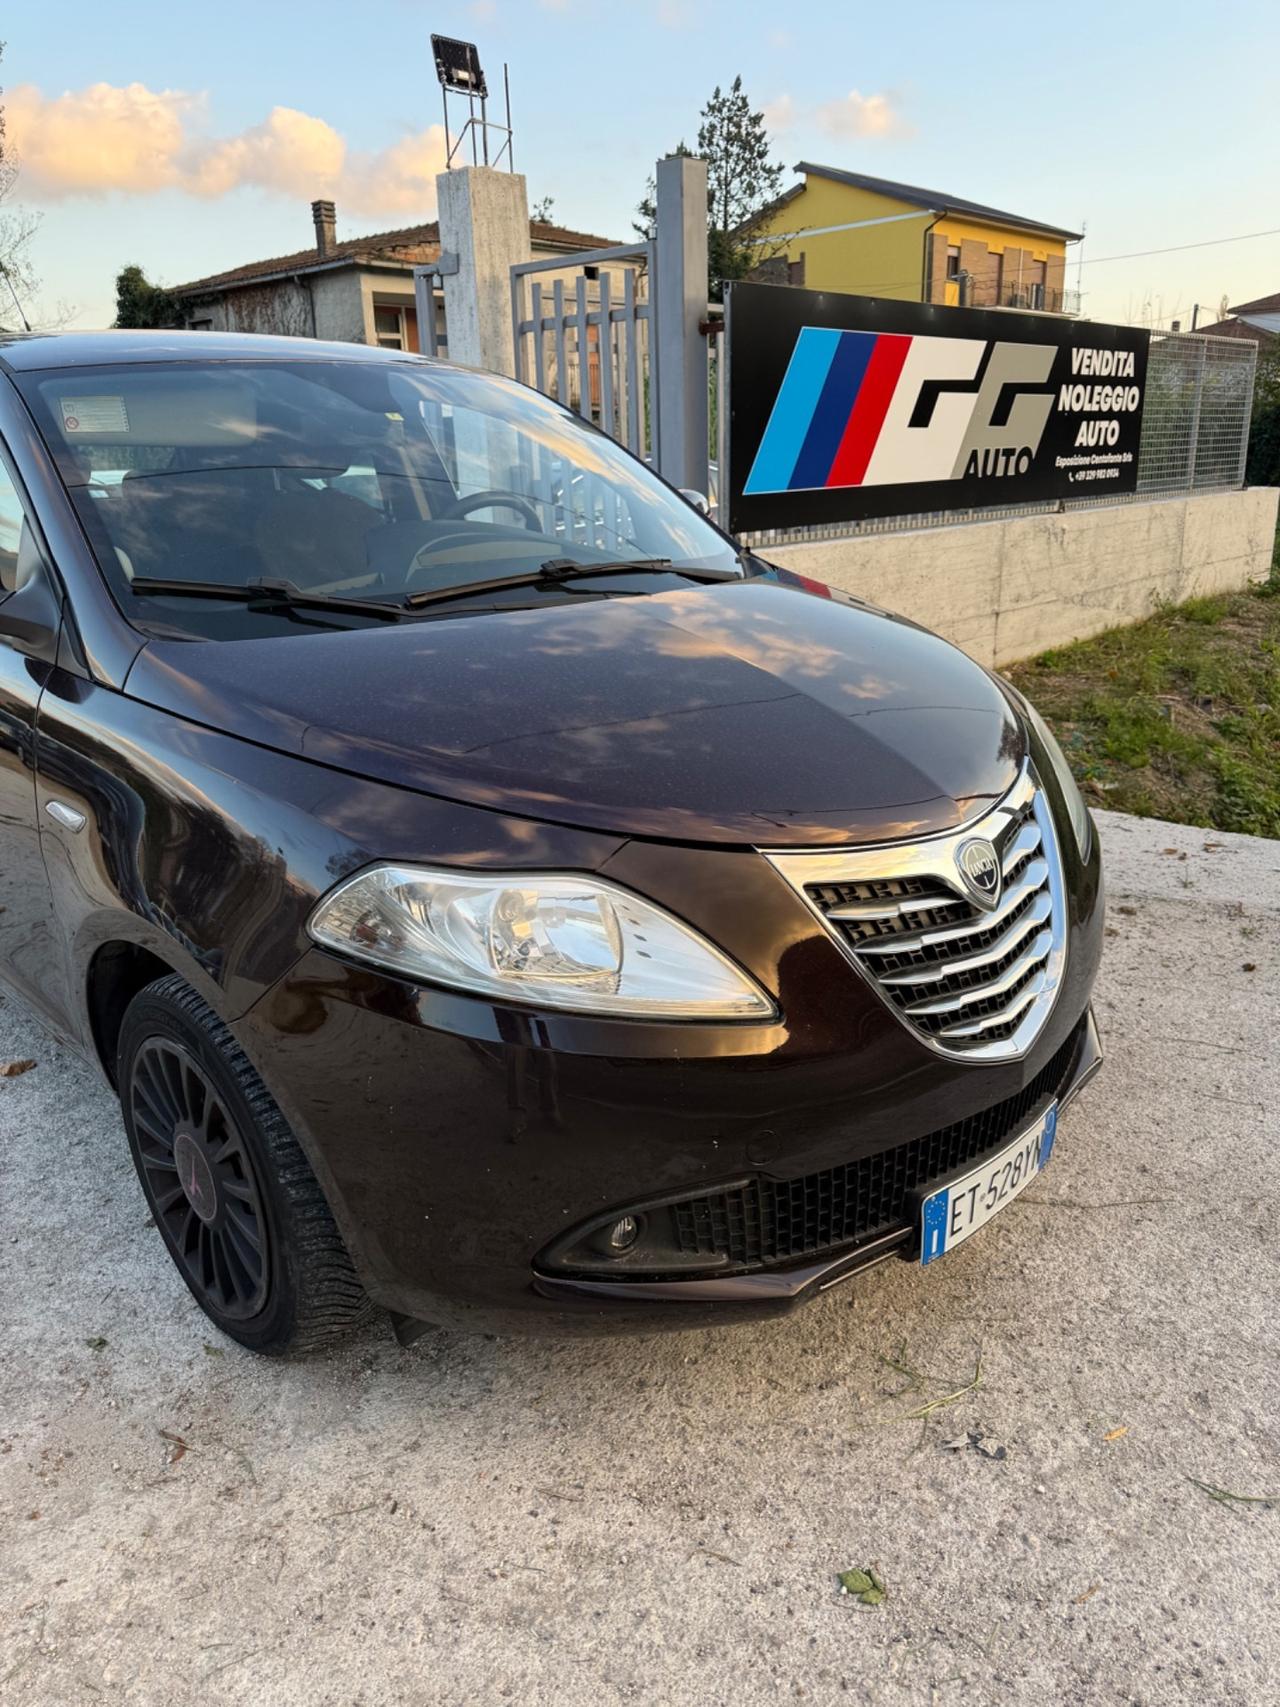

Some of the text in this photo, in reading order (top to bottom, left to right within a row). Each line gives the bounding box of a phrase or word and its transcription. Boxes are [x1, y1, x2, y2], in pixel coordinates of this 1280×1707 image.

[1071, 347, 1135, 377] VENDITA
[1057, 384, 1140, 412] NOLEGGIO
[1074, 419, 1120, 447] AUTO
[964, 446, 1032, 481] AUTO
[1055, 454, 1090, 469] Esposizione
